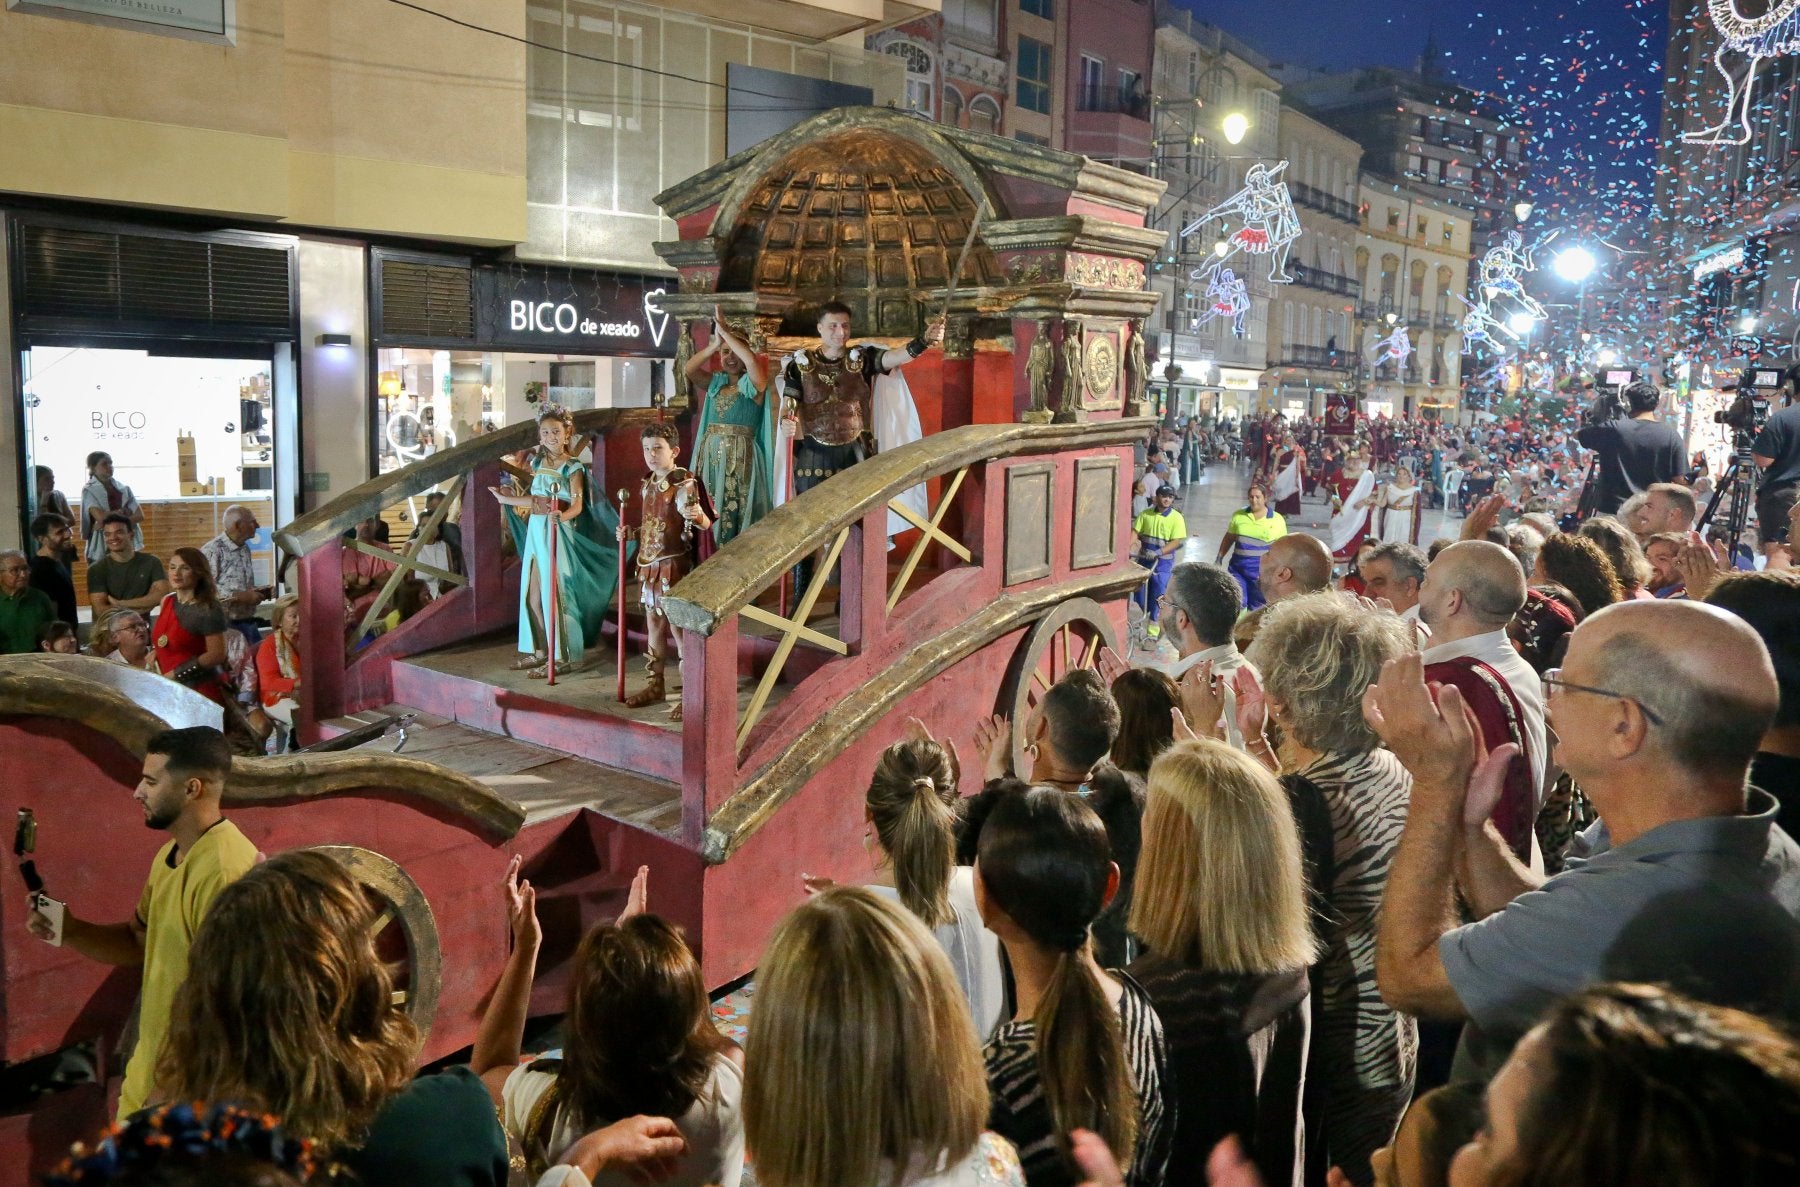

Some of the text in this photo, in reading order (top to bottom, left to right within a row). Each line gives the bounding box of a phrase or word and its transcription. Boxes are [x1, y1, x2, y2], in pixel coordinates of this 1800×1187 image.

[510, 300, 640, 337] BICO de xeado
[91, 411, 146, 429] BICO
